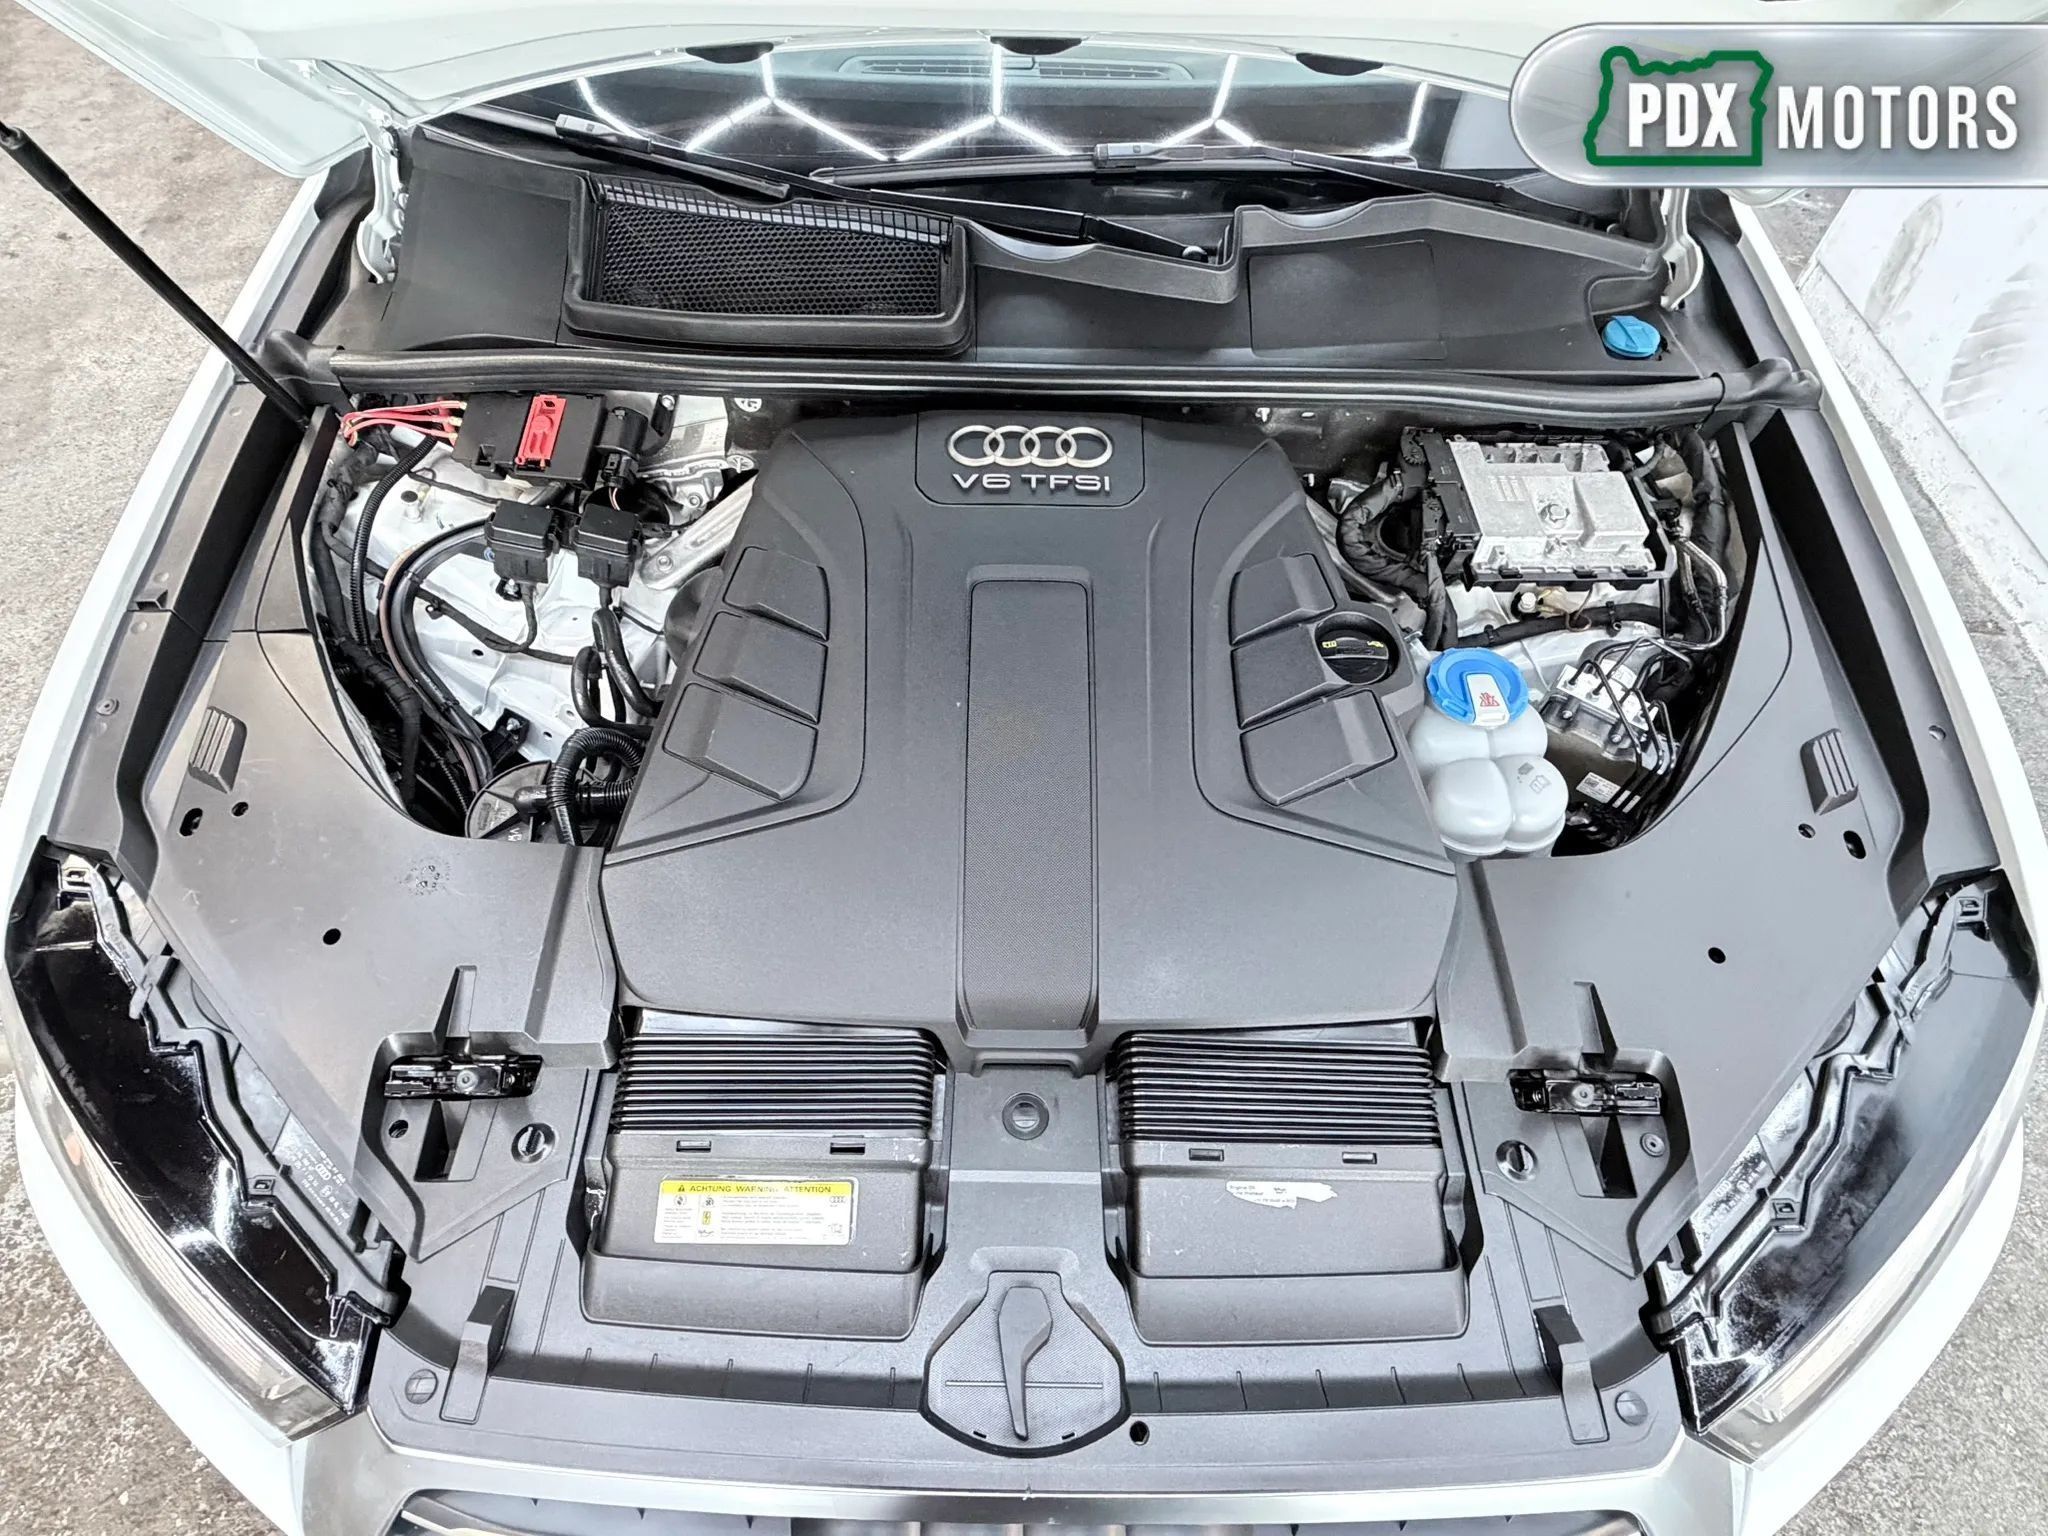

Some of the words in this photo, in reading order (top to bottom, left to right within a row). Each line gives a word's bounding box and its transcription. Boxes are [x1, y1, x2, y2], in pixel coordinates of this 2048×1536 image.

[952, 473, 1012, 489] V6
[1021, 474, 1110, 491] TFSI
[689, 1185, 732, 1193] ACHTUNG
[784, 1185, 832, 1193] ATTENTION
